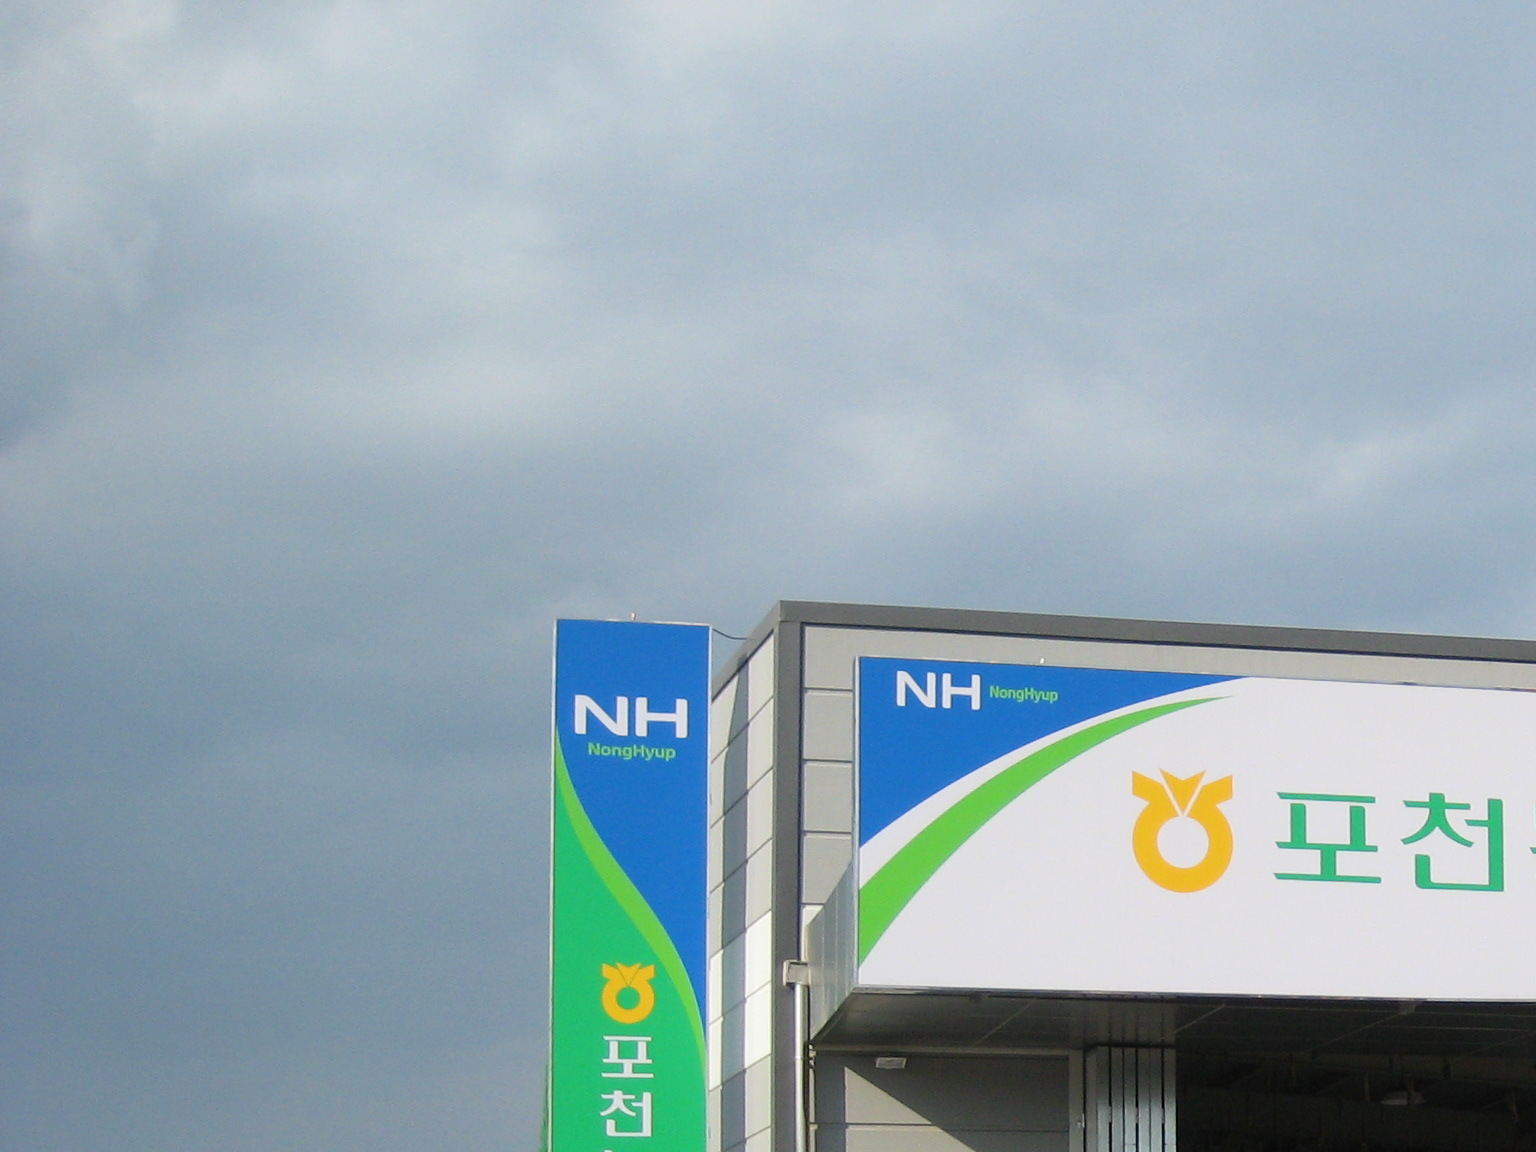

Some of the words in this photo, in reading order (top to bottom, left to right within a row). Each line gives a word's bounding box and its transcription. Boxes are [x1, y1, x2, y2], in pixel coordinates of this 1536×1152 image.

[895, 670, 982, 710] NH
[989, 684, 1059, 702] NongHyup
[573, 694, 689, 739] NH
[587, 741, 676, 762] NongHyup
